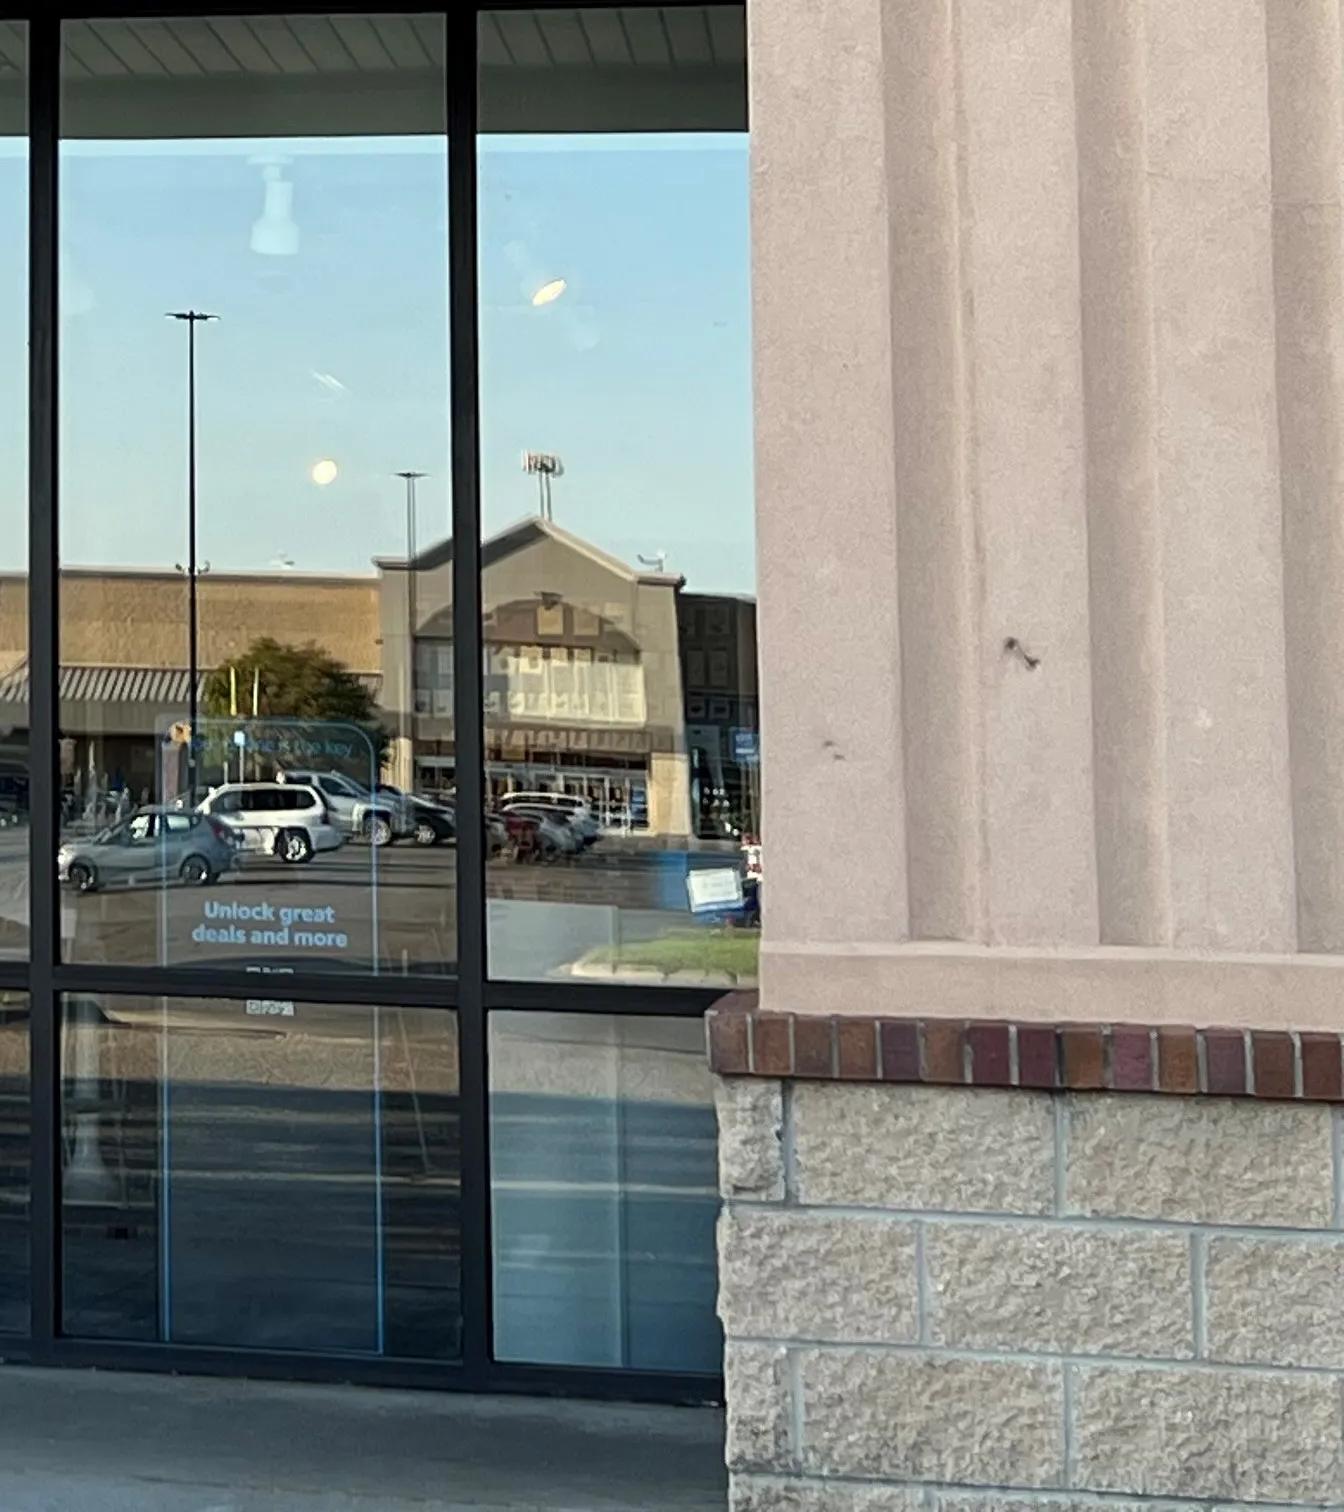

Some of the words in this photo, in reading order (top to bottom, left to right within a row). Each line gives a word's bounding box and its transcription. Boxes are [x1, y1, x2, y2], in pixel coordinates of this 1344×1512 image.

[204, 901, 275, 921] Unlock
[279, 905, 335, 926] great
[192, 925, 246, 943] deals
[250, 927, 289, 945] and
[293, 932, 348, 947] more
